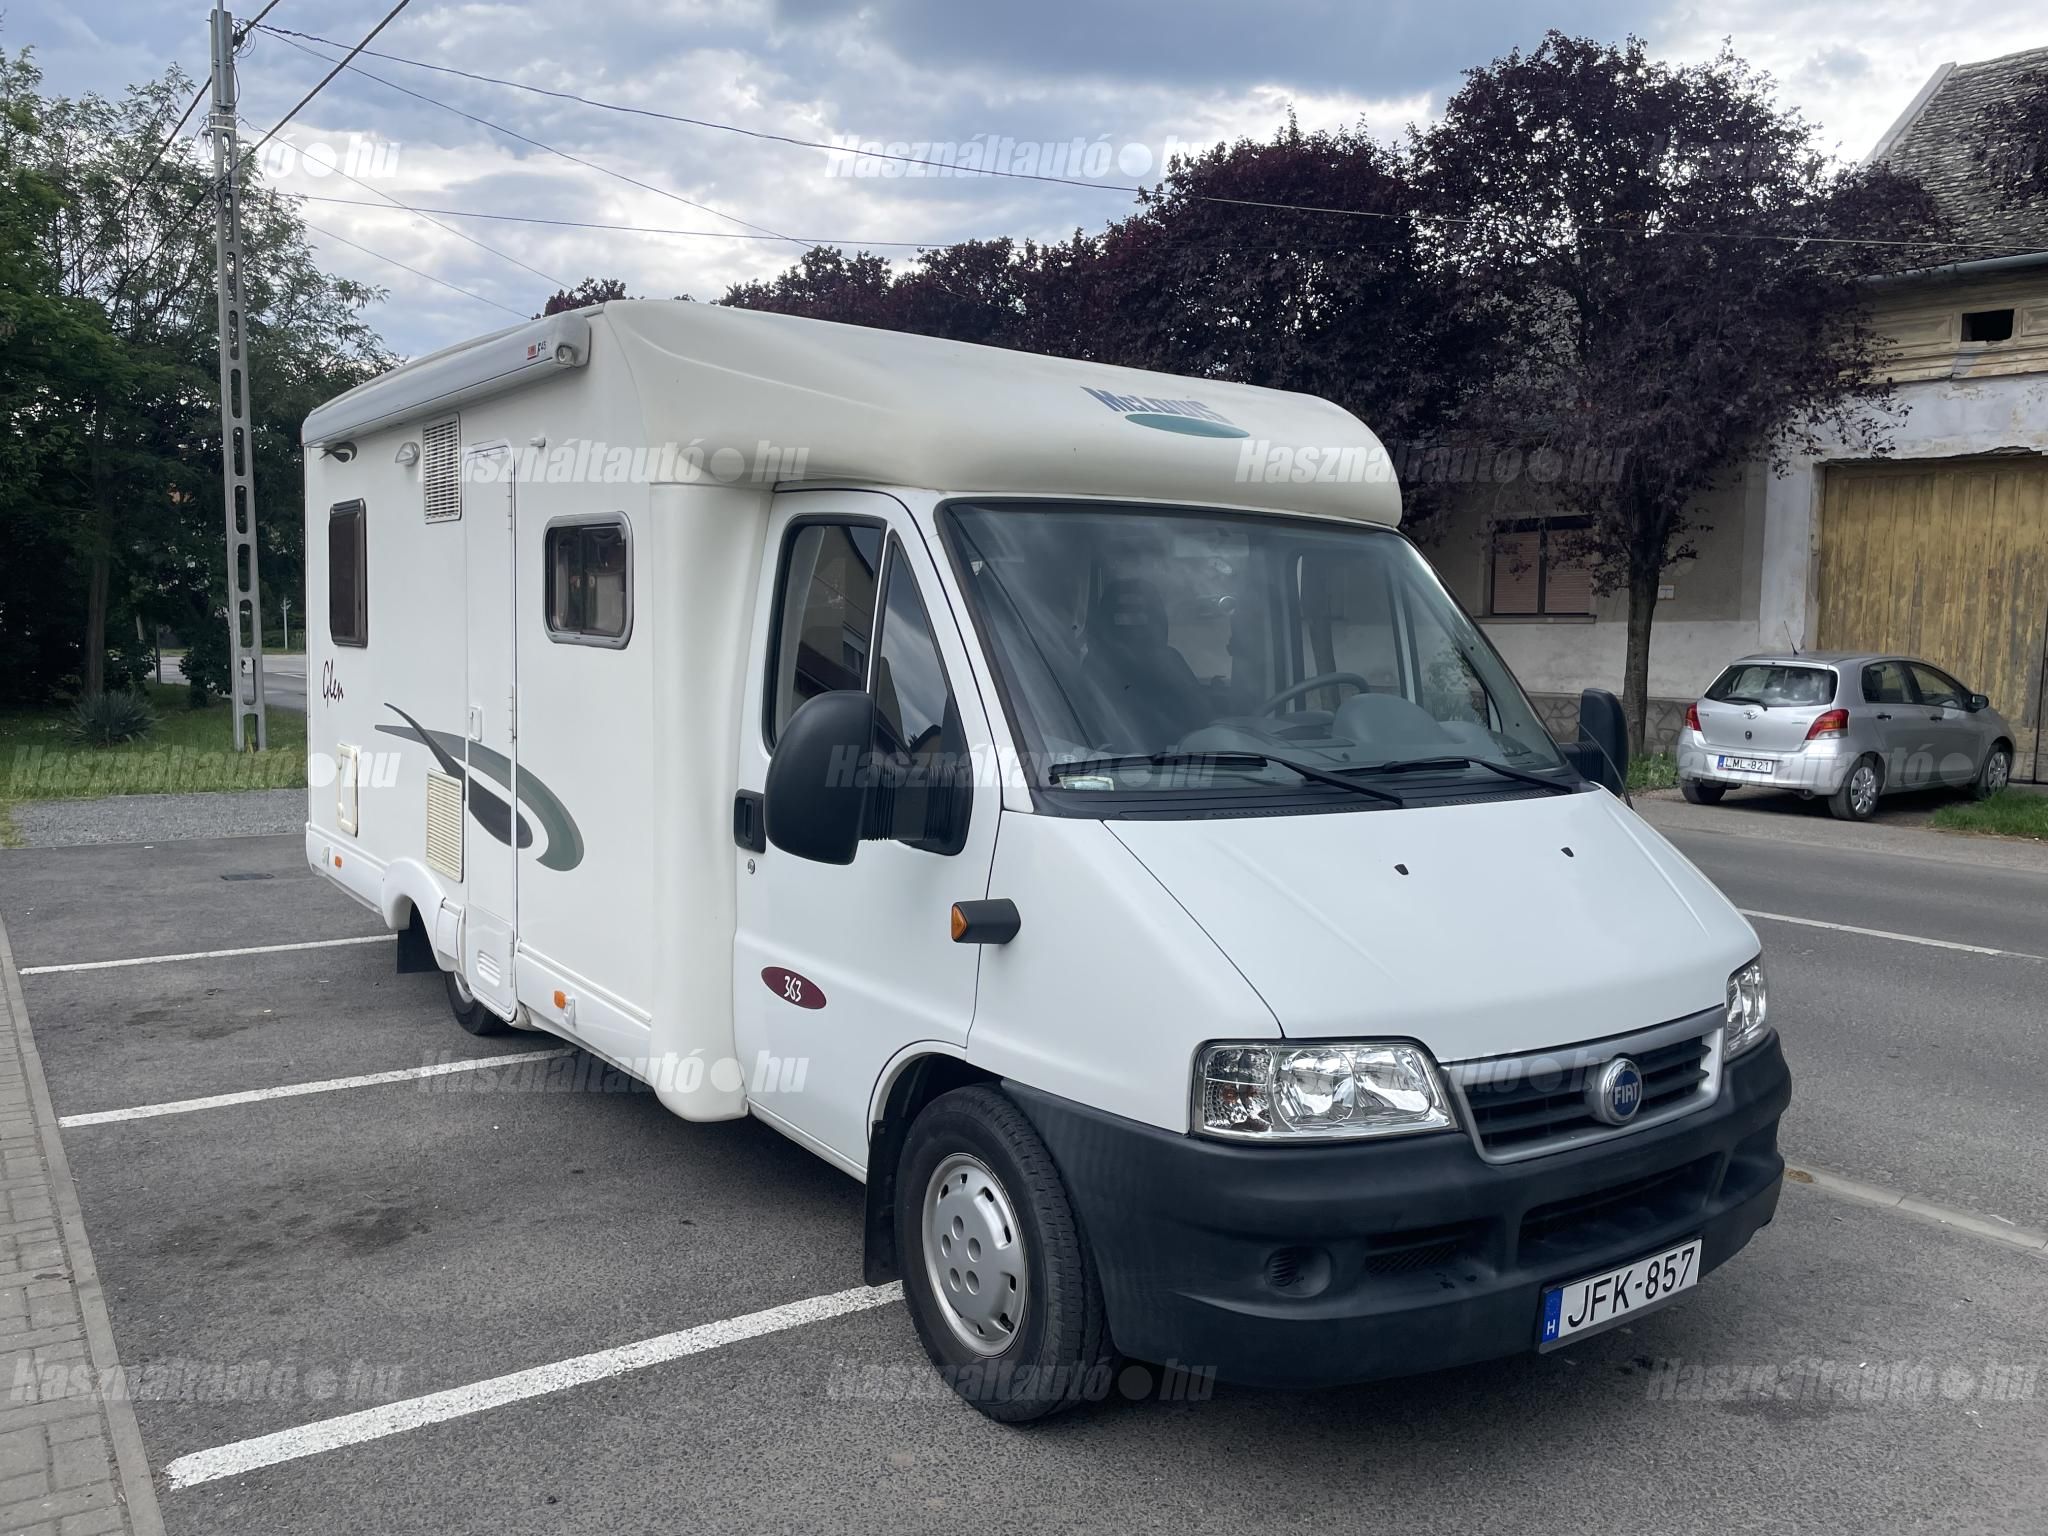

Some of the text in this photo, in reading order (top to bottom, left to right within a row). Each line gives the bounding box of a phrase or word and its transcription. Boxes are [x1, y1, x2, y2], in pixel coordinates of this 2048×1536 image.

[322, 657, 344, 709] Glen
[1725, 756, 1770, 771] LML-821
[783, 975, 802, 1003] 363
[1614, 1081, 1639, 1105] FIAT
[1546, 1246, 1695, 1336] H JFK-857
